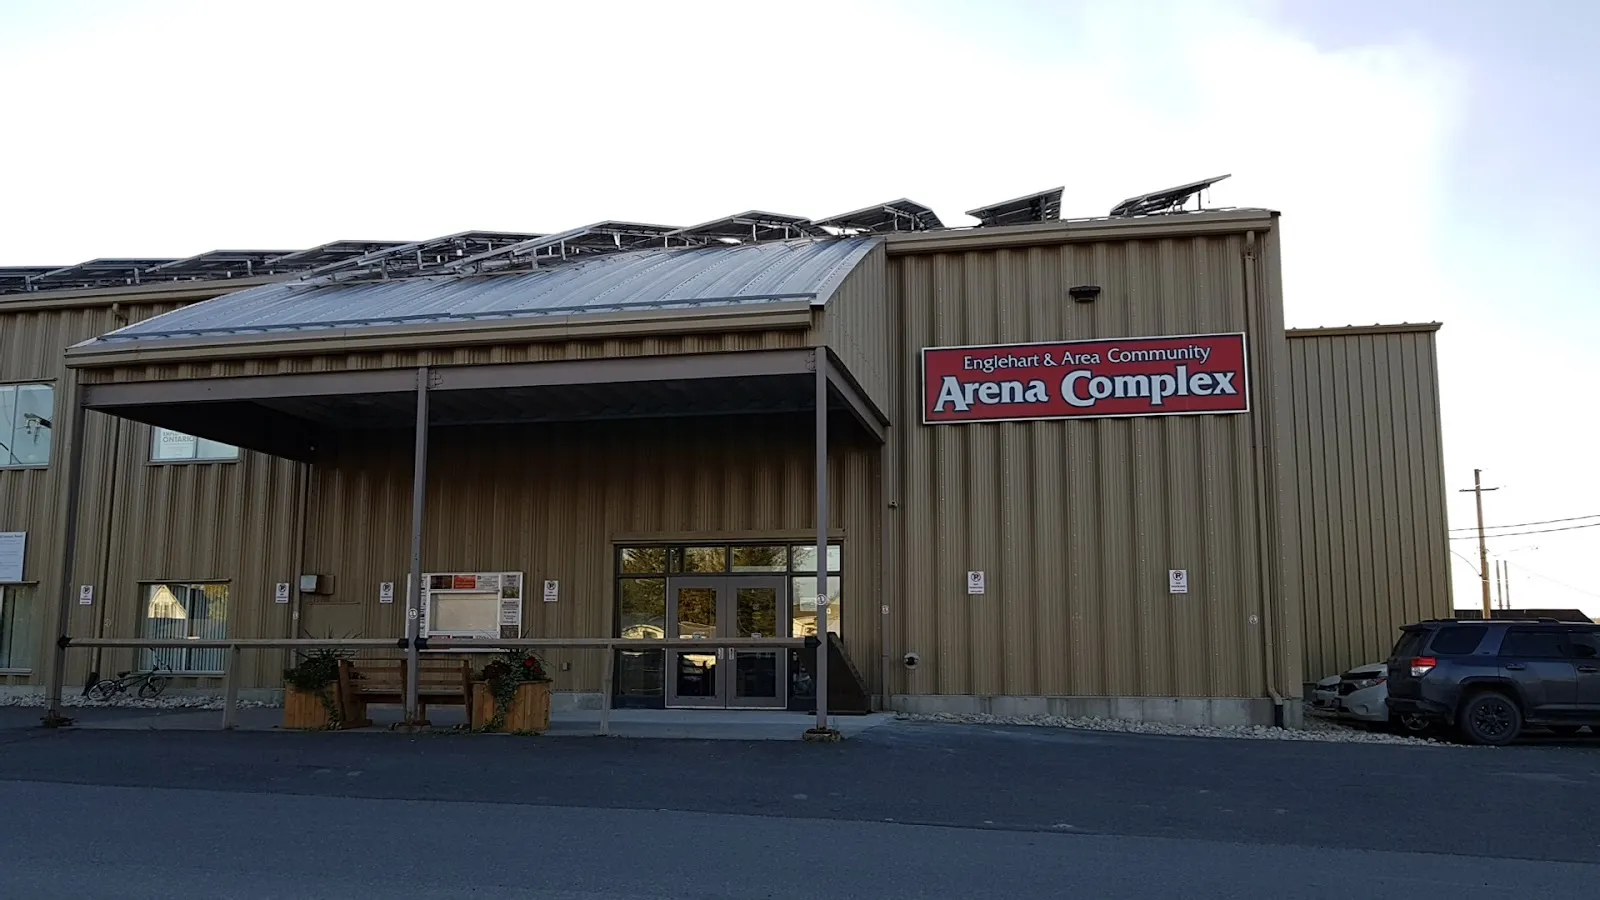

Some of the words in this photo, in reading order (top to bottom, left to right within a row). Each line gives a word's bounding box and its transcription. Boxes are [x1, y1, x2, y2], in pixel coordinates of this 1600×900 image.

[964, 355, 1040, 373] Englehart
[1043, 353, 1057, 366] &
[1061, 351, 1101, 365] Area
[1107, 345, 1211, 364] Community
[933, 375, 1050, 412] Arena
[1061, 365, 1237, 407] Complex
